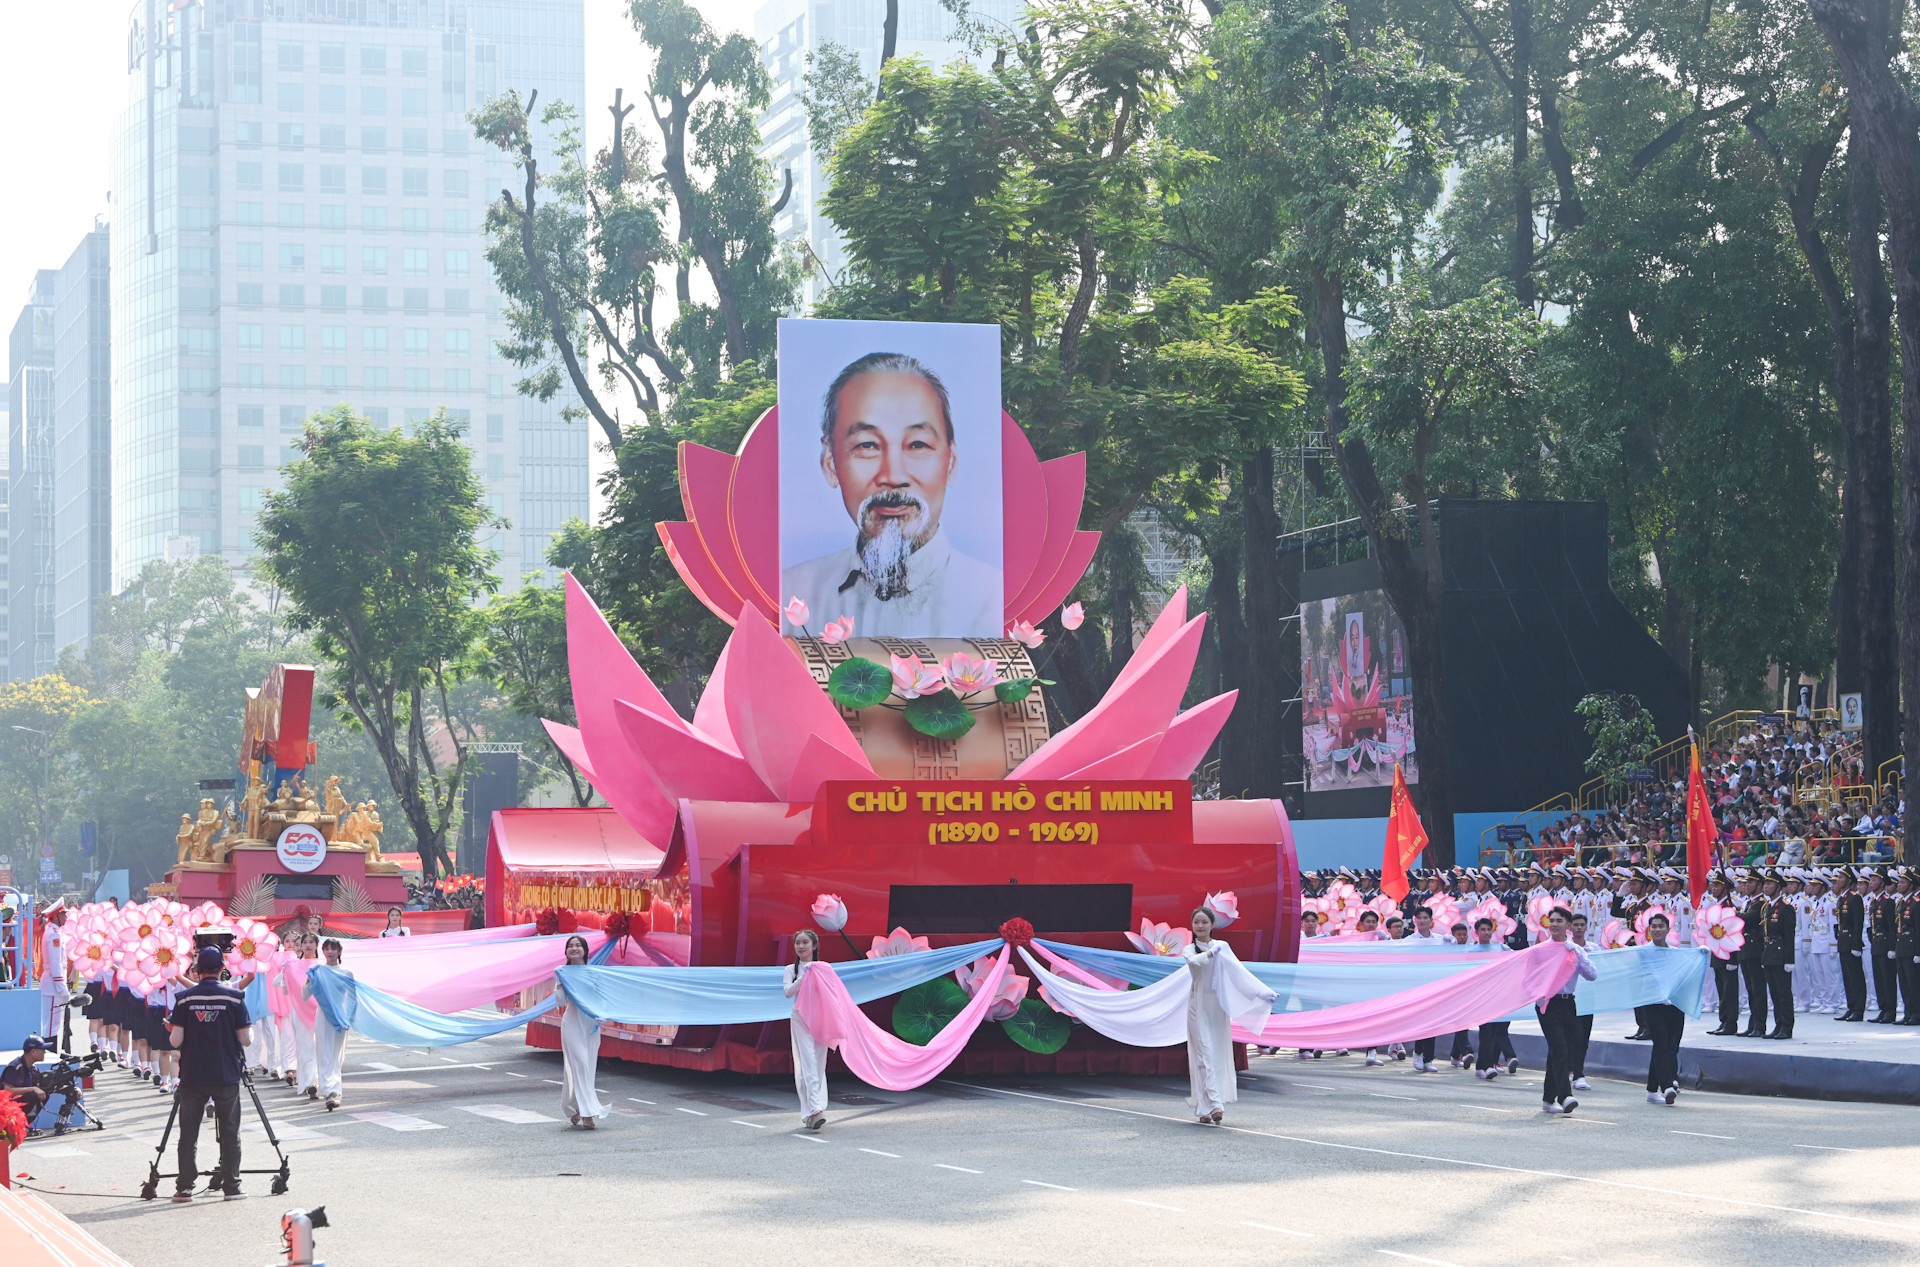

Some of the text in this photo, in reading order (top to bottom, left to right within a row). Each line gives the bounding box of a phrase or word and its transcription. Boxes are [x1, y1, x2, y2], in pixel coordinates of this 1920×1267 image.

[848, 783, 1173, 815] CHỦ TỊCH HỒ CHÍ MINH
[928, 822, 999, 845] (1890
[1029, 822, 1099, 845] 1969)
[195, 1010, 219, 1022] VTV
